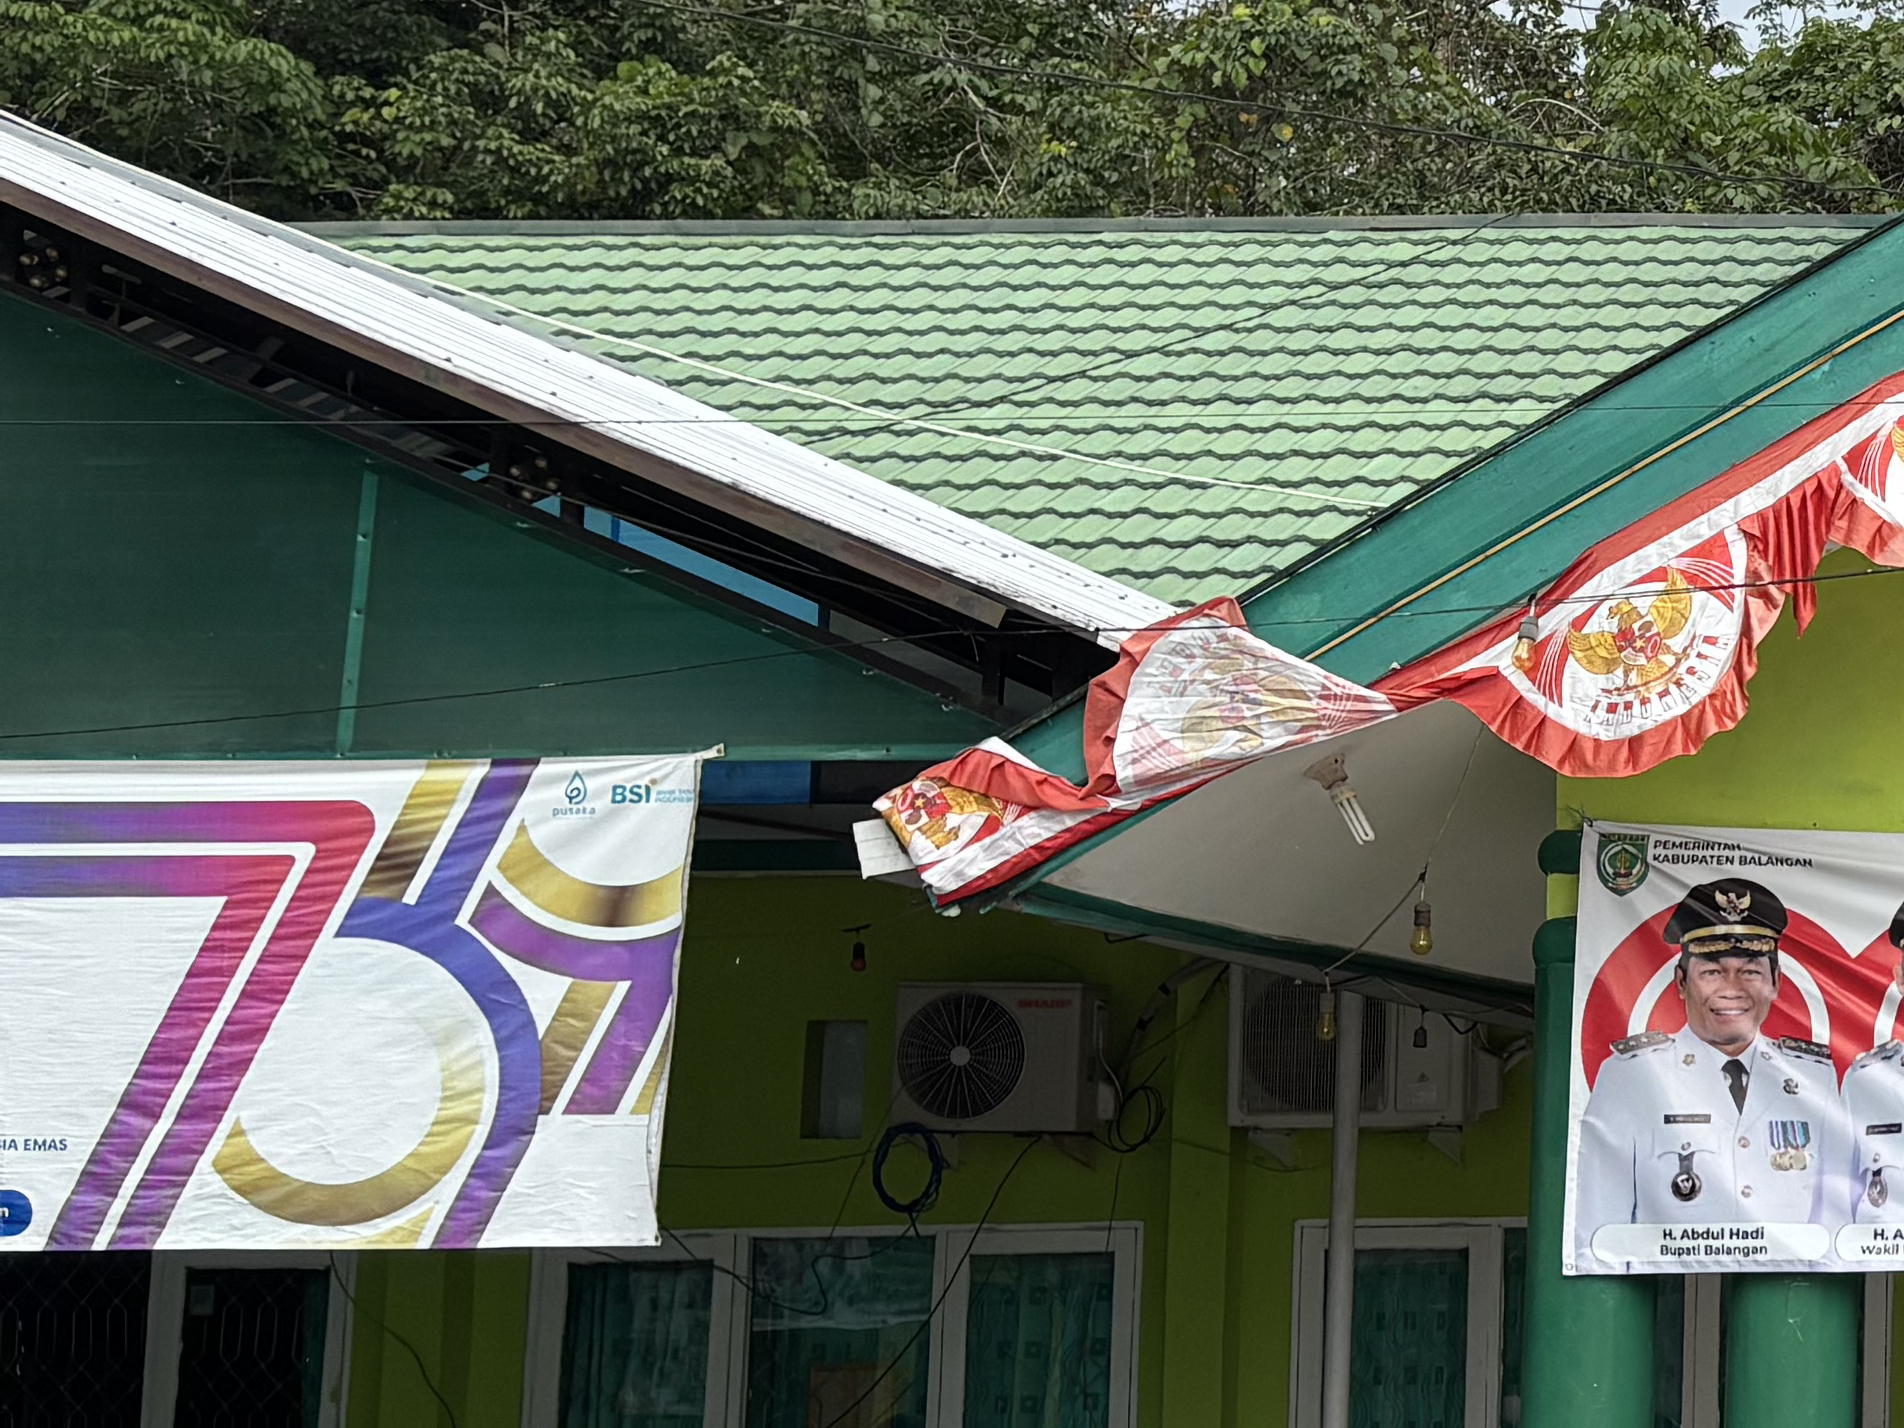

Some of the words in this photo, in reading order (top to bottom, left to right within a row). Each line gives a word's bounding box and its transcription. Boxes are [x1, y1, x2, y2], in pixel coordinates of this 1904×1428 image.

[611, 784, 651, 804] BSI
[1653, 853, 1735, 866] KABUPATEN
[1739, 855, 1813, 867] BALANGAN
[23, 1138, 68, 1151] EMAS
[1663, 1227, 1677, 1241] H.
[1680, 1227, 1726, 1242] Abdul
[1729, 1227, 1765, 1241] Hadi
[1873, 1228, 1889, 1241] H.
[1660, 1242, 1701, 1257] Bupati
[1704, 1242, 1768, 1258] Balangan
